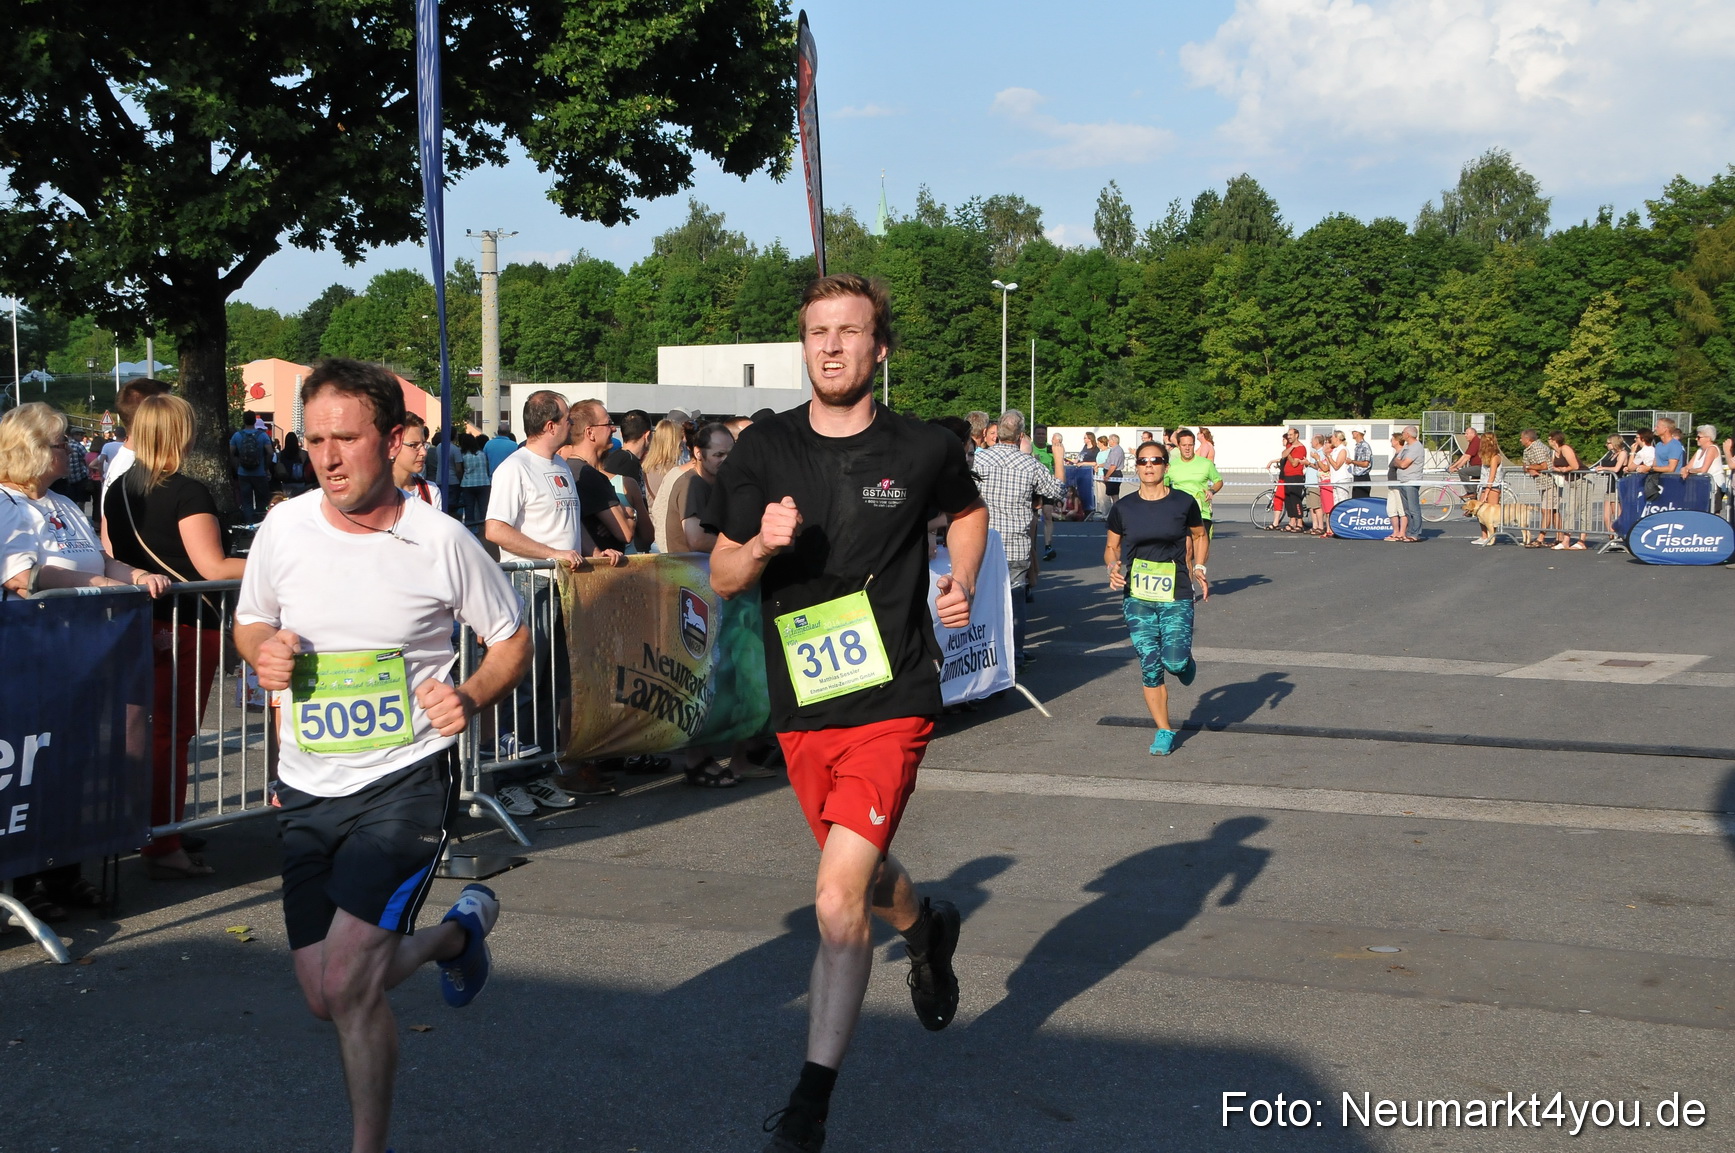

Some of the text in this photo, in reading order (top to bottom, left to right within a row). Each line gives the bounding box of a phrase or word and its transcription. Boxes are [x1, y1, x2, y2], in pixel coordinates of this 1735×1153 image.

[862, 489, 906, 498] GSTANDN
[1348, 515, 1392, 526] Fische
[1655, 533, 1724, 547] Fischer
[1133, 573, 1173, 592] 1179
[797, 629, 868, 679] 318
[941, 642, 998, 682] ammsbräu
[643, 643, 714, 703] Neumarkte
[301, 695, 405, 741] 5095
